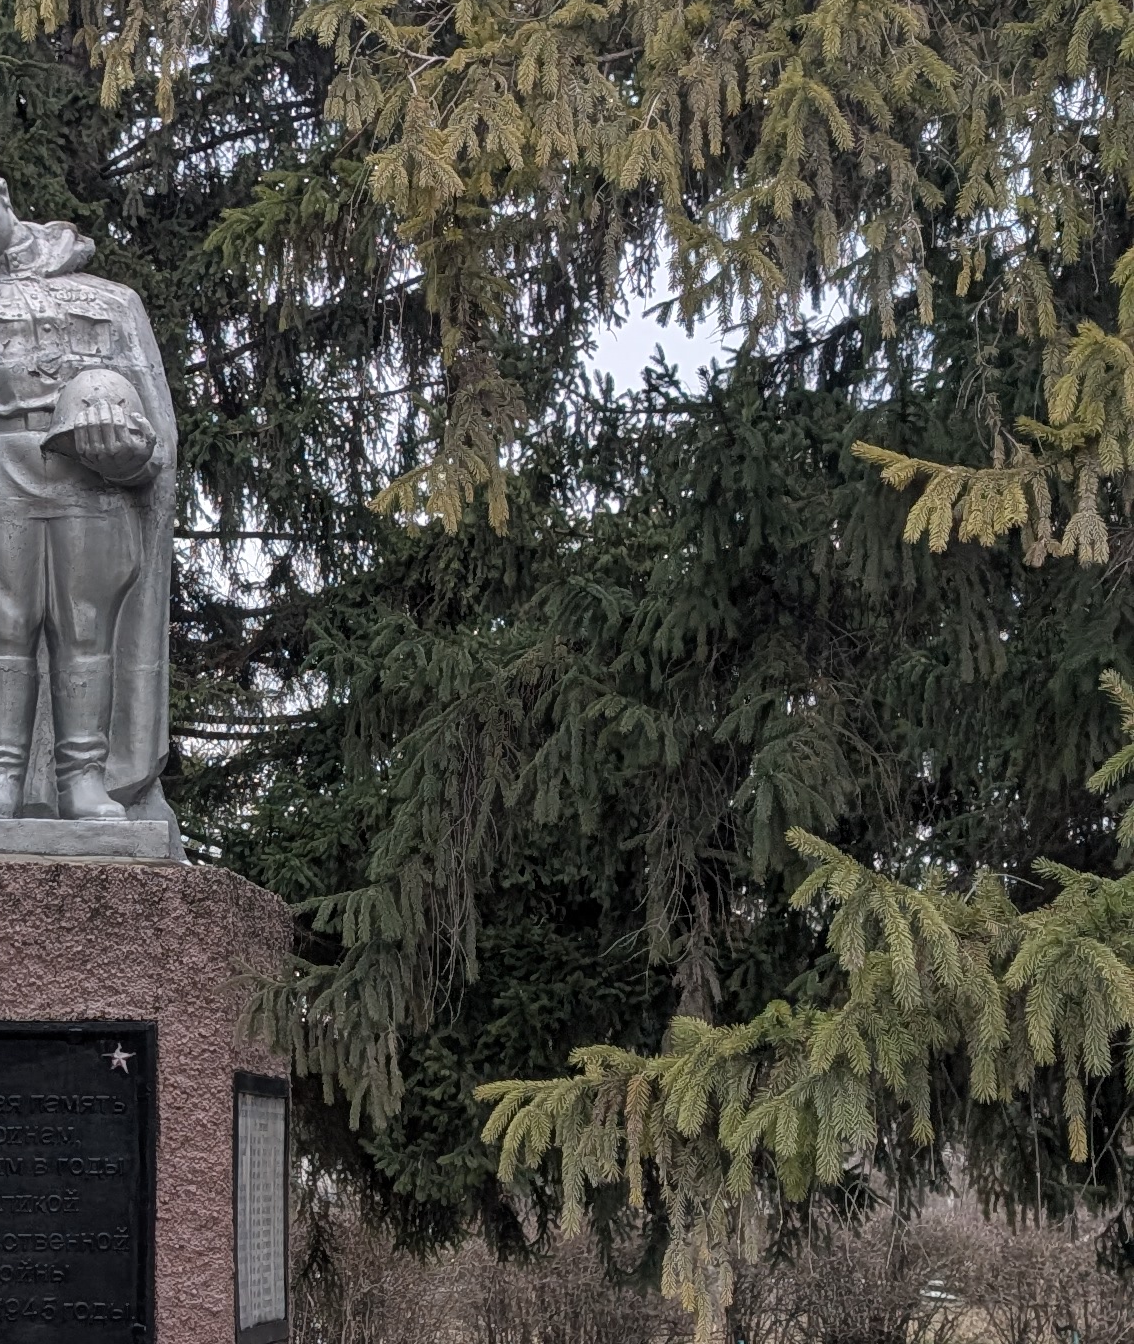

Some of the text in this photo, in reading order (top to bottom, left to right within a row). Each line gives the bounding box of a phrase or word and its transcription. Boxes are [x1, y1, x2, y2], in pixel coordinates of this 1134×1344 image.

[30, 1094, 127, 1115] память
[33, 1157, 49, 1177] в
[56, 1157, 125, 1179] годы
